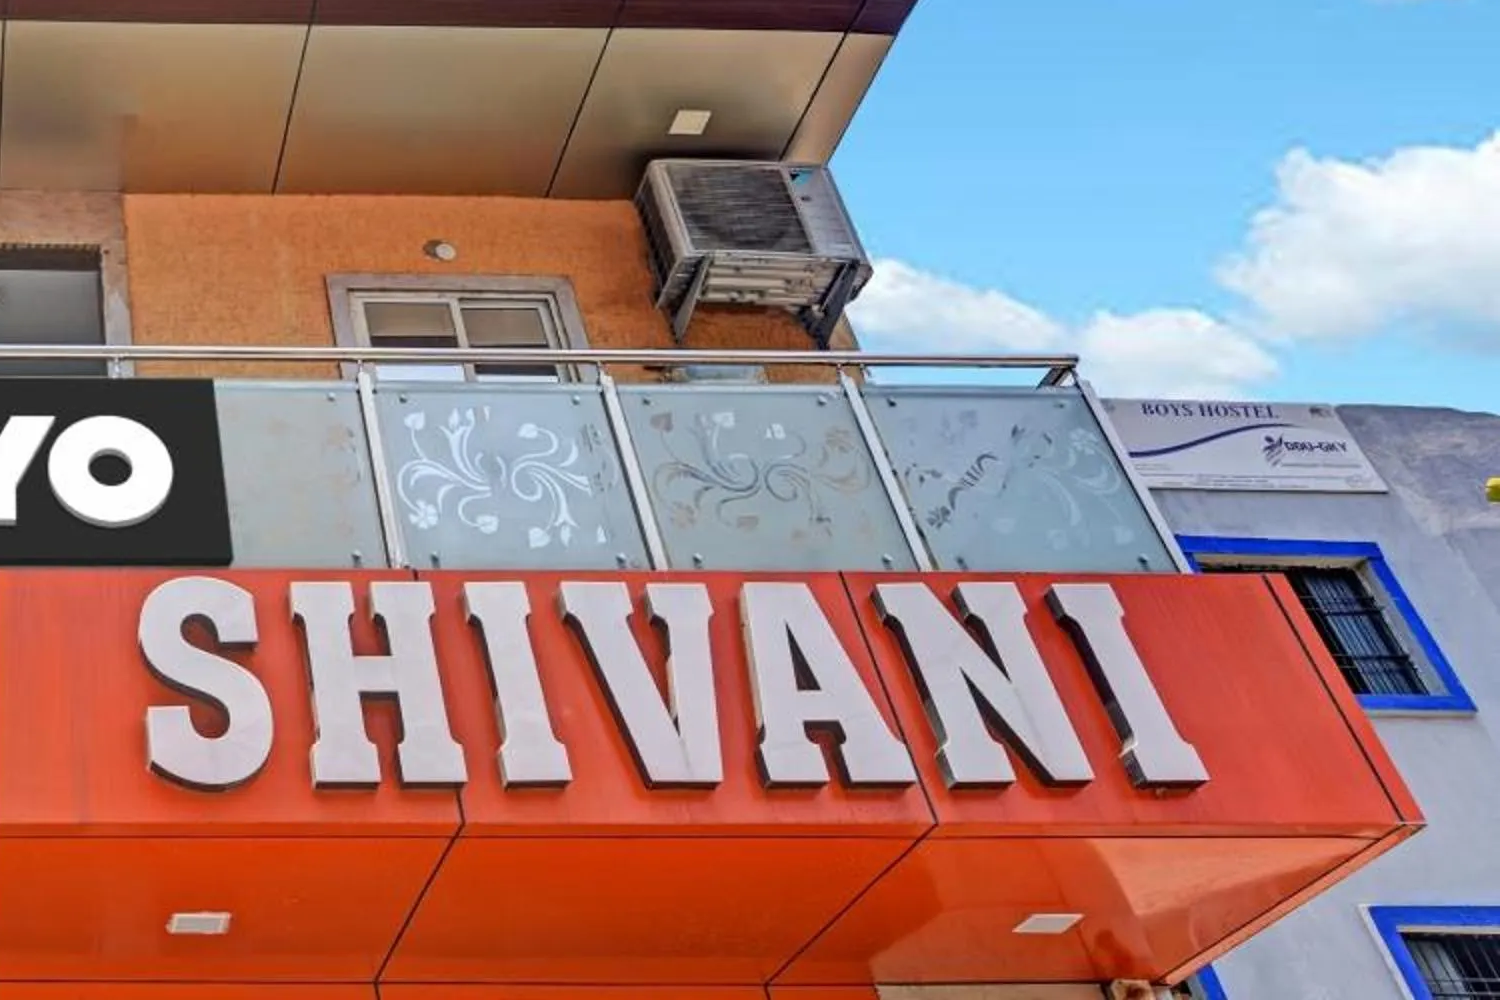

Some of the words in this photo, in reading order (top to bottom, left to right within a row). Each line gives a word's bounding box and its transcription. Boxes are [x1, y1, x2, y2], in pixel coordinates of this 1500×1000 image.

[1141, 402, 1193, 417] BOYS
[1199, 403, 1278, 419] HOSTEL
[137, 575, 1211, 791] SHIVANI
